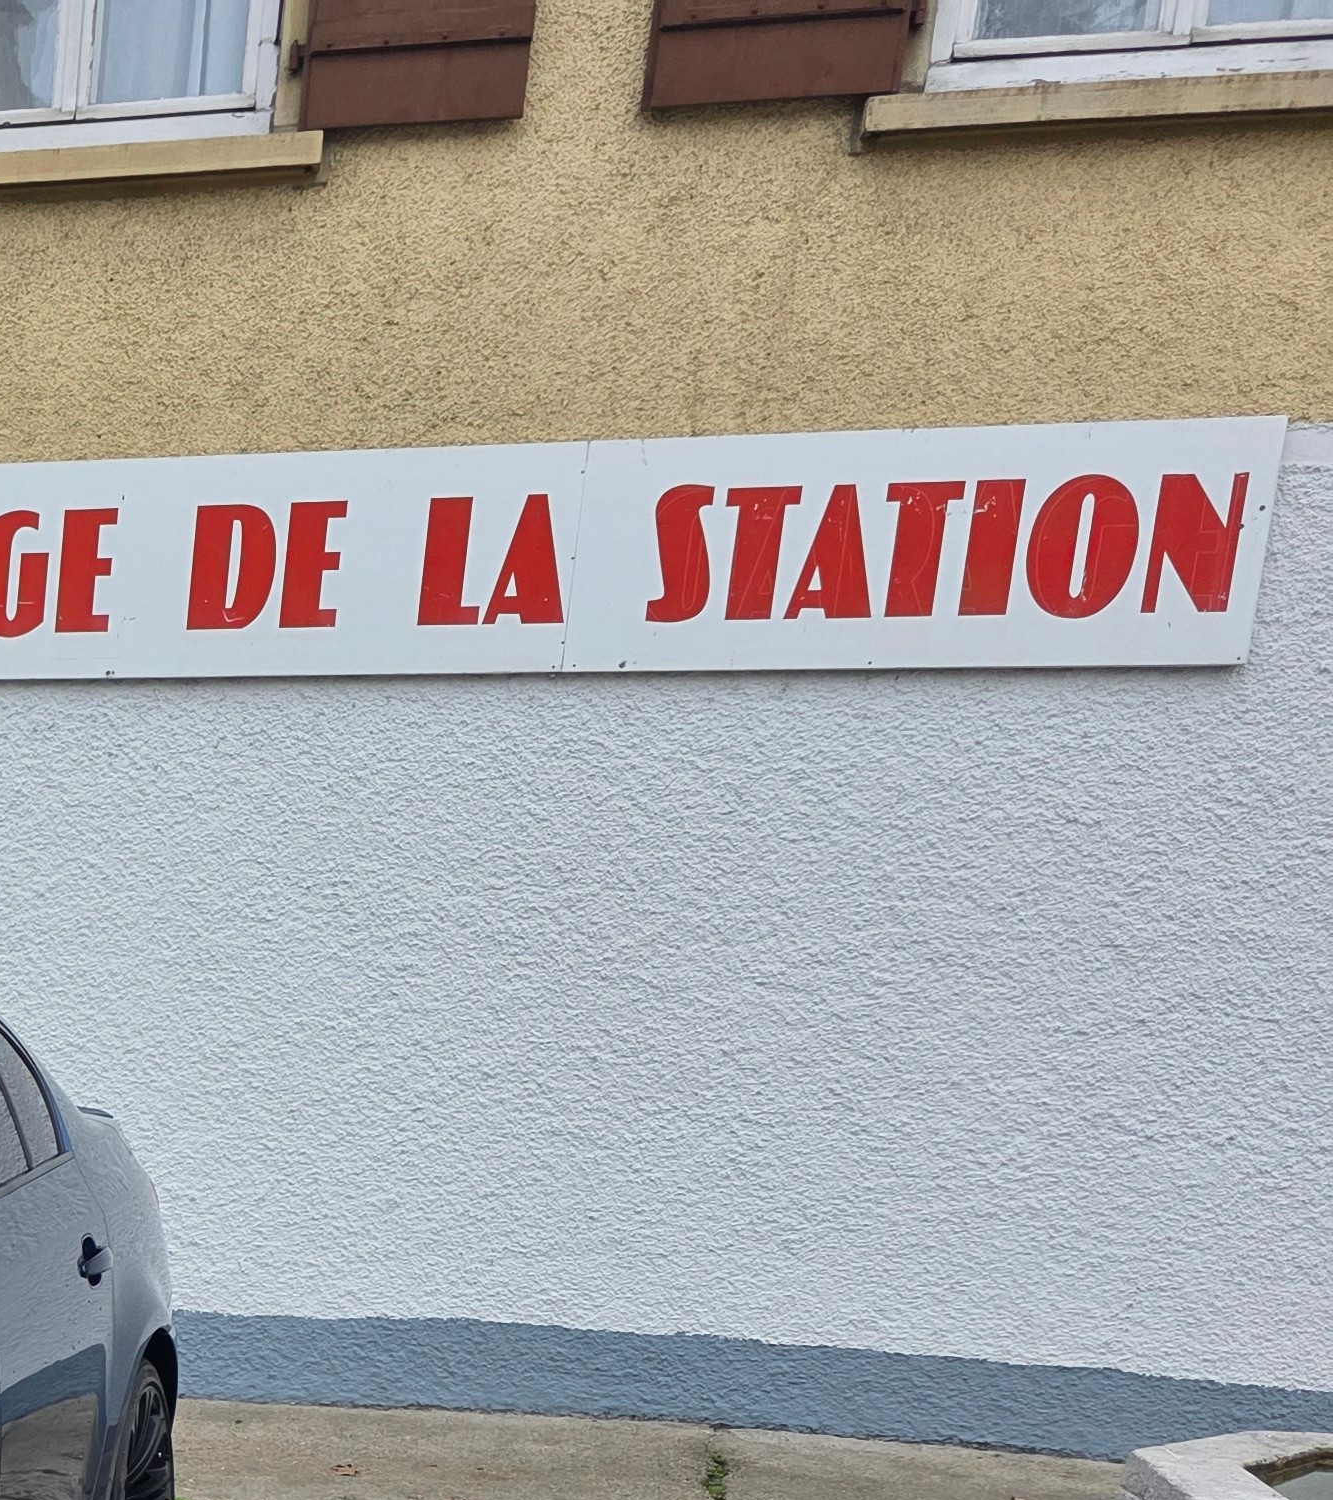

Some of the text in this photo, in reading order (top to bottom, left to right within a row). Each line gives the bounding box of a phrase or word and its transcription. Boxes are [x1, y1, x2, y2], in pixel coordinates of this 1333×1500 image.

[186, 501, 348, 630] DE
[417, 494, 564, 626] LA
[645, 472, 1251, 623] STATION
